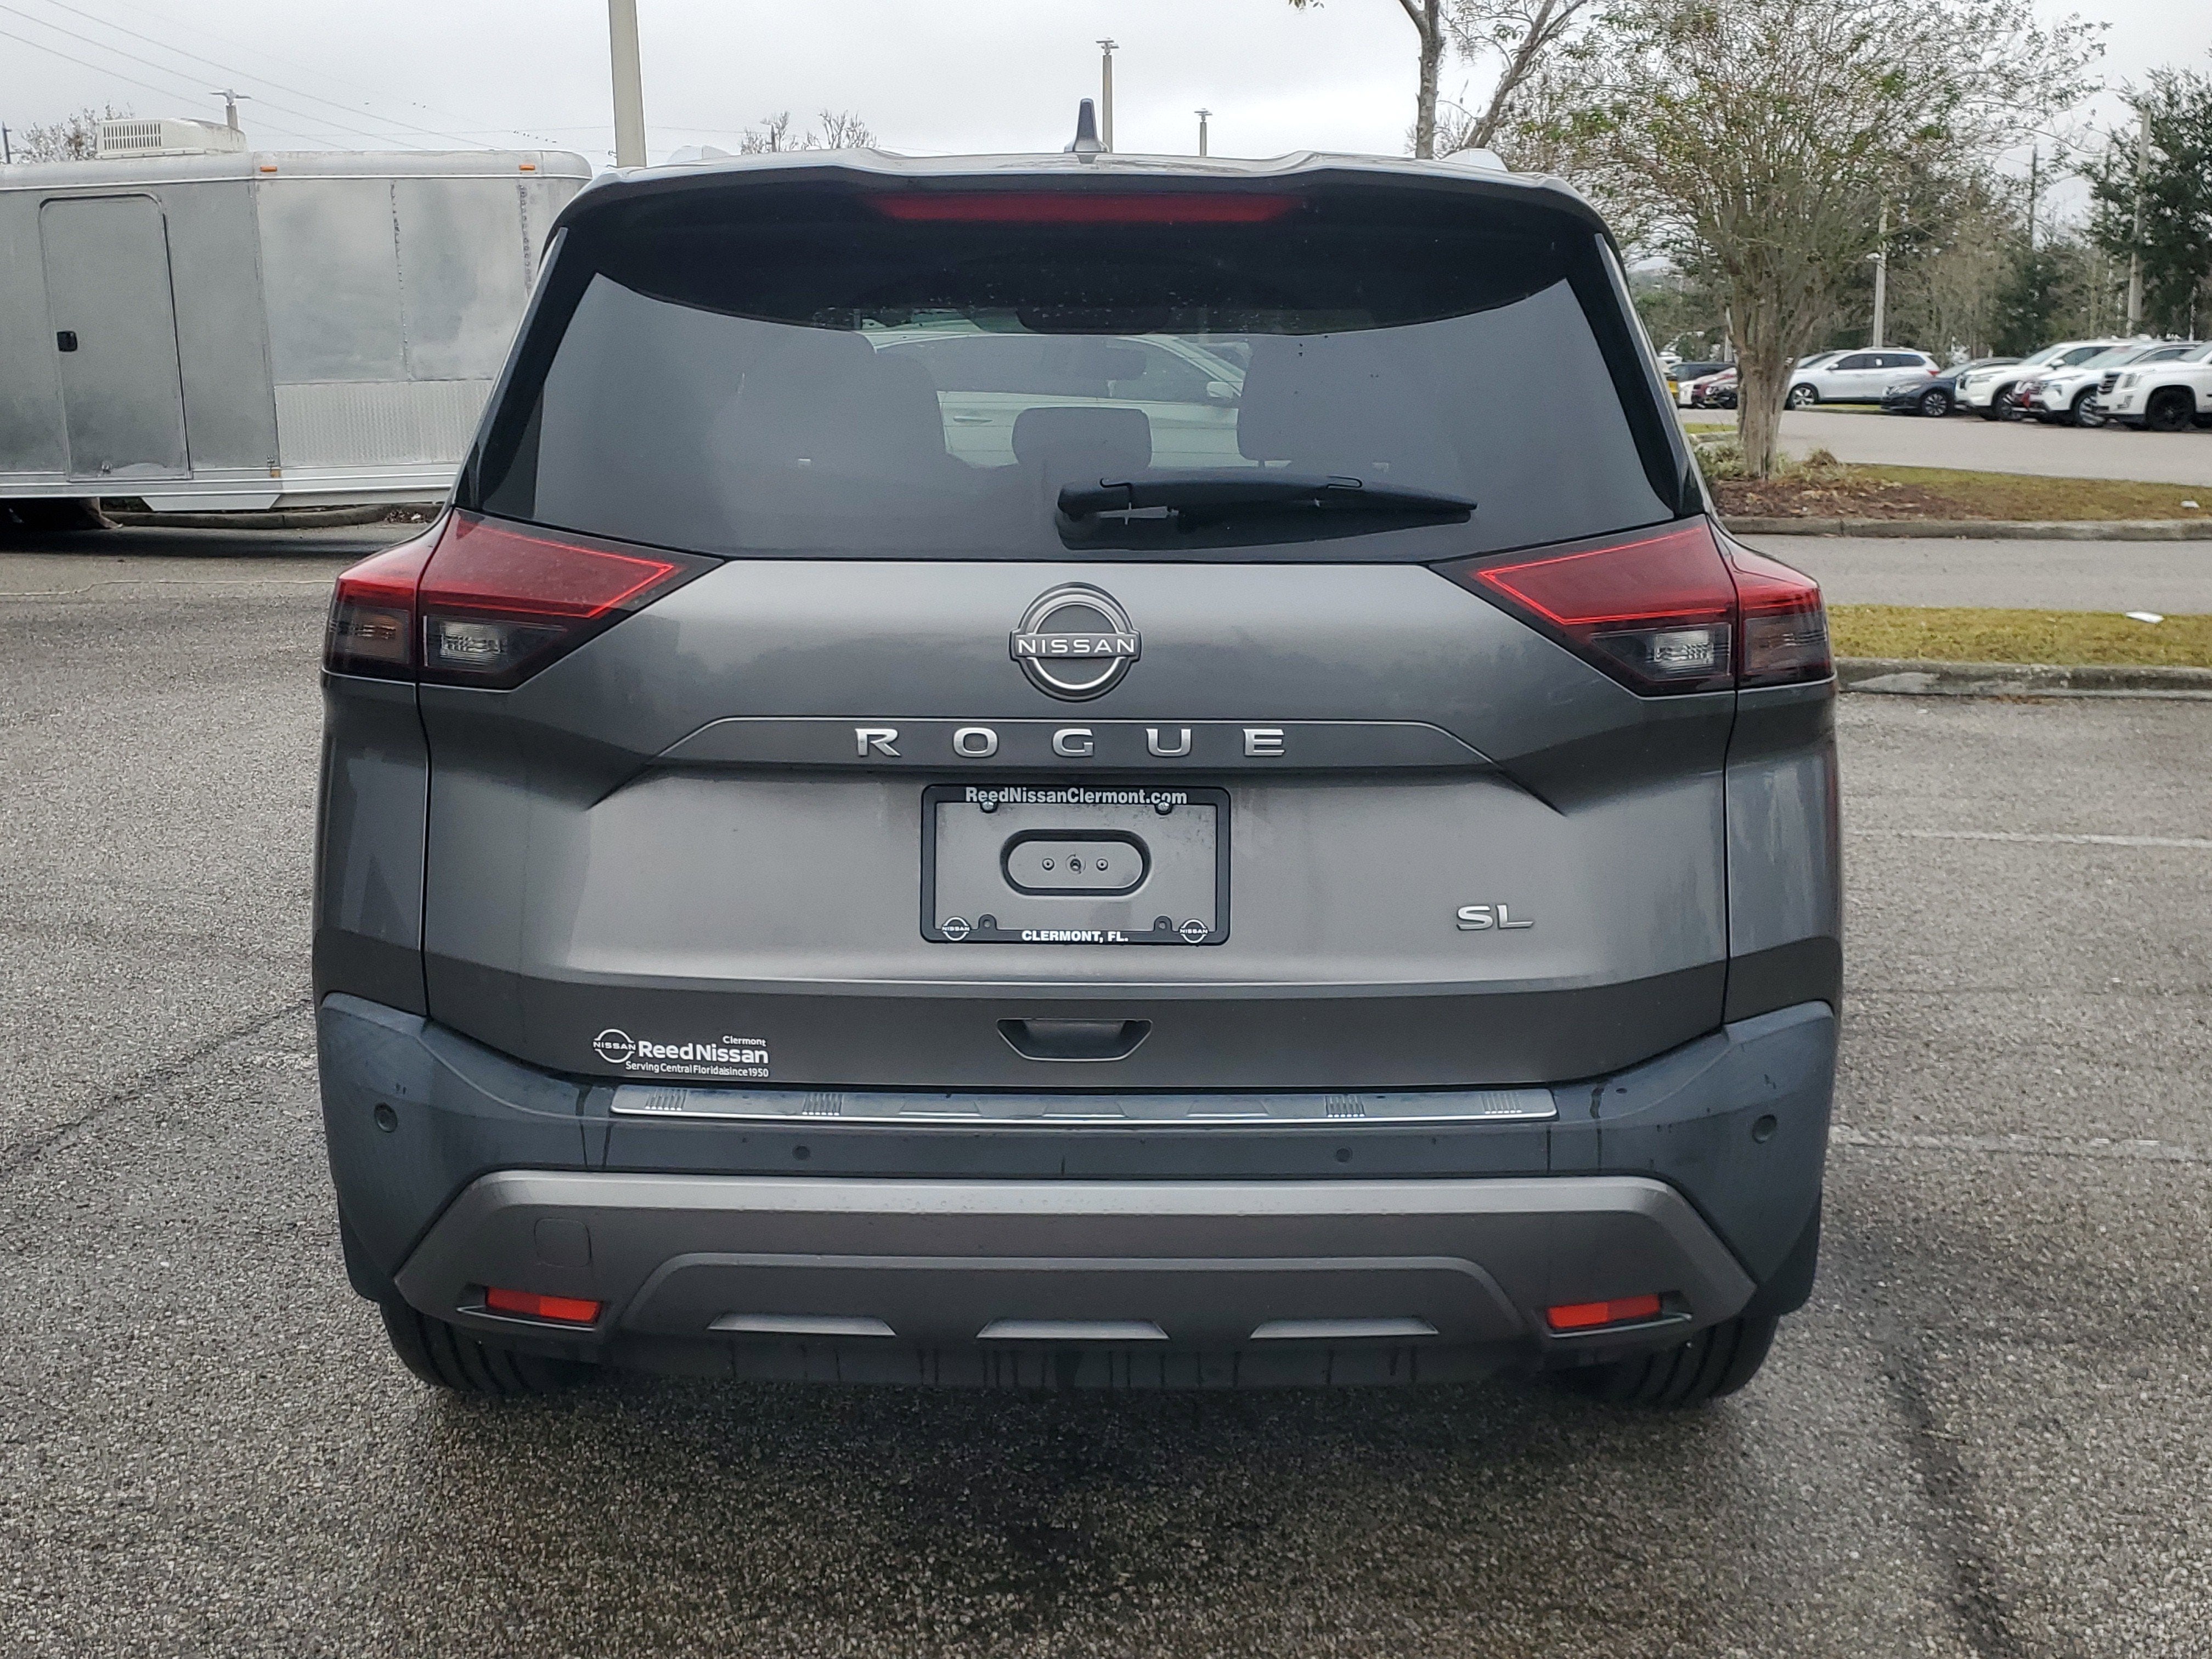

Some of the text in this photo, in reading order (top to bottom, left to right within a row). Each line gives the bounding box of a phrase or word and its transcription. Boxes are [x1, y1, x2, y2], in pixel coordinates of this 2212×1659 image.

[1018, 639, 1135, 653] NISSAN
[855, 727, 1285, 758] ROGUE
[966, 787, 1187, 805] ReedNissanClermont.com
[1457, 904, 1533, 930] SL
[1022, 930, 1128, 943] CLERMONT, FL.
[593, 1041, 636, 1051] NISSAN
[723, 1035, 766, 1047] Clermont
[625, 1061, 659, 1073] Serving
[660, 1063, 692, 1073] Central
[748, 1068, 769, 1077] 1950
